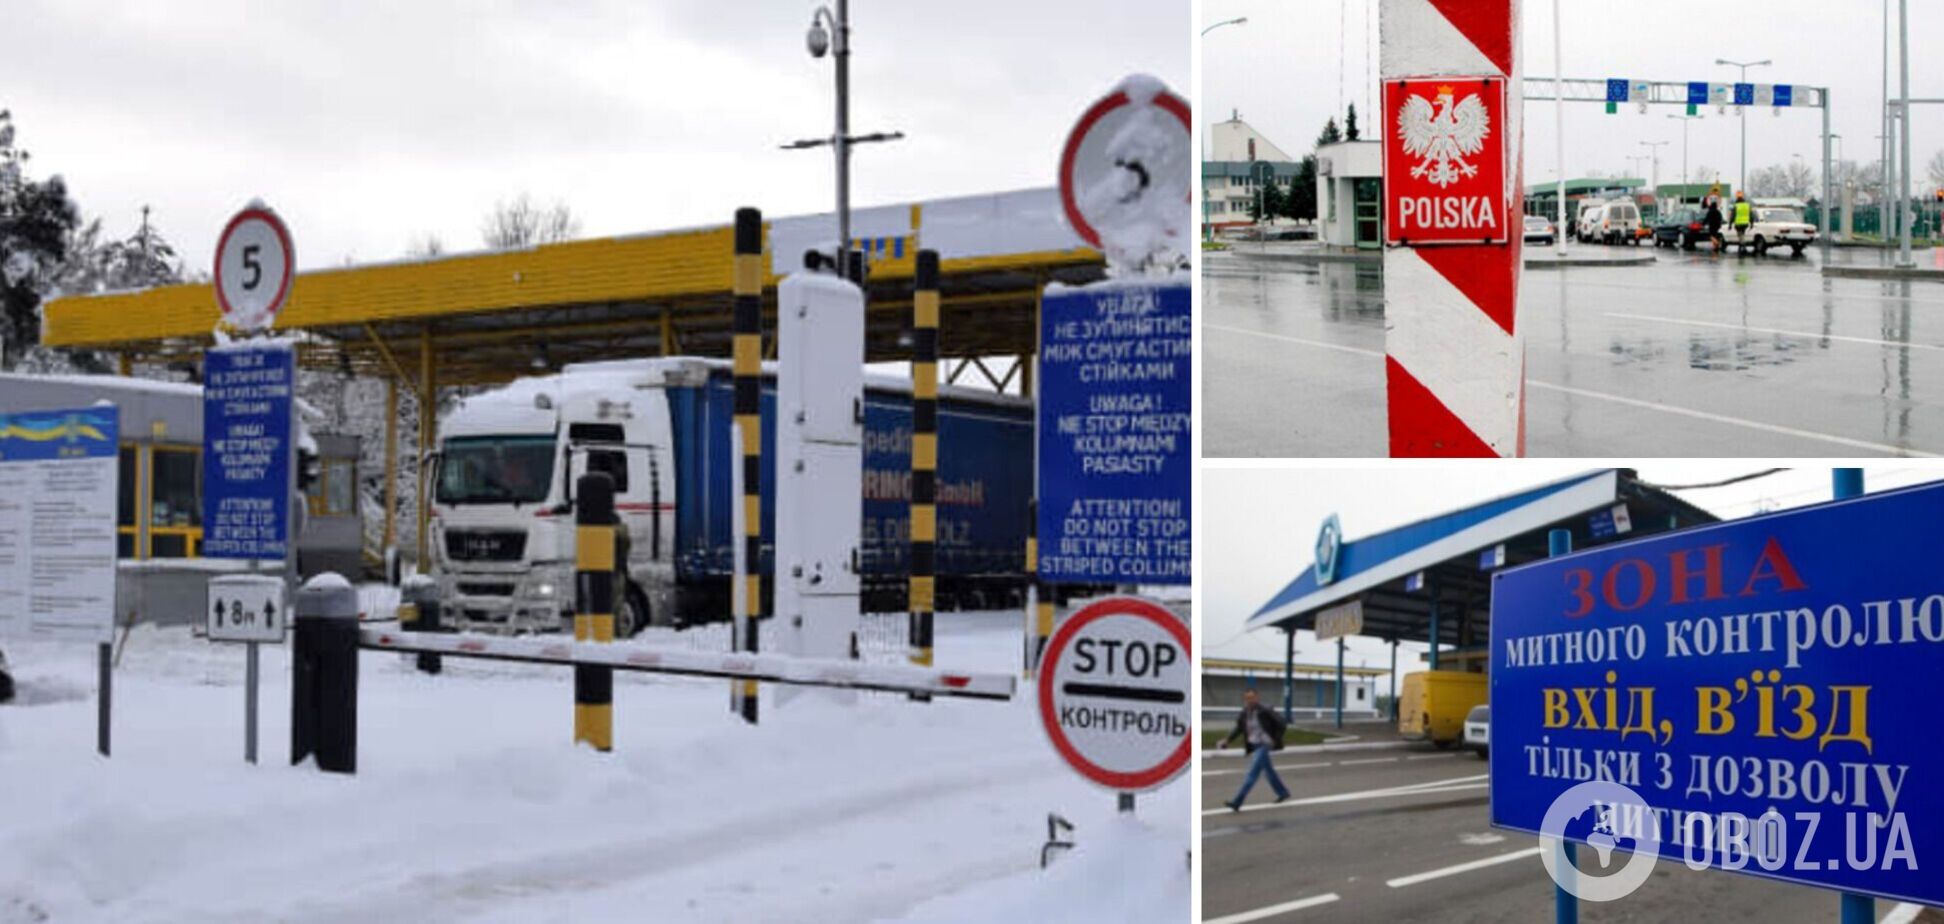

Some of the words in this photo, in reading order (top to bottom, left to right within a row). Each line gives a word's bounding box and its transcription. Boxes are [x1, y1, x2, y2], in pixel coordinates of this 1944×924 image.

[1398, 196, 1497, 229] POLSKA
[241, 245, 262, 290] 5
[1079, 361, 1175, 383] СТІЙКАМИ
[1086, 414, 1129, 433] STOP
[1063, 518, 1089, 535] DO
[1093, 518, 1132, 536] NOT
[1136, 518, 1188, 538] STOP
[1060, 536, 1149, 556] BETWEEN
[1153, 537, 1191, 557] THE
[1041, 555, 1115, 576] STRIPED
[1118, 555, 1191, 577] COLUM
[1562, 536, 1808, 618] ЗОНА
[1073, 637, 1177, 678] STOP
[1061, 706, 1187, 737] КОНТРОЛЬ
